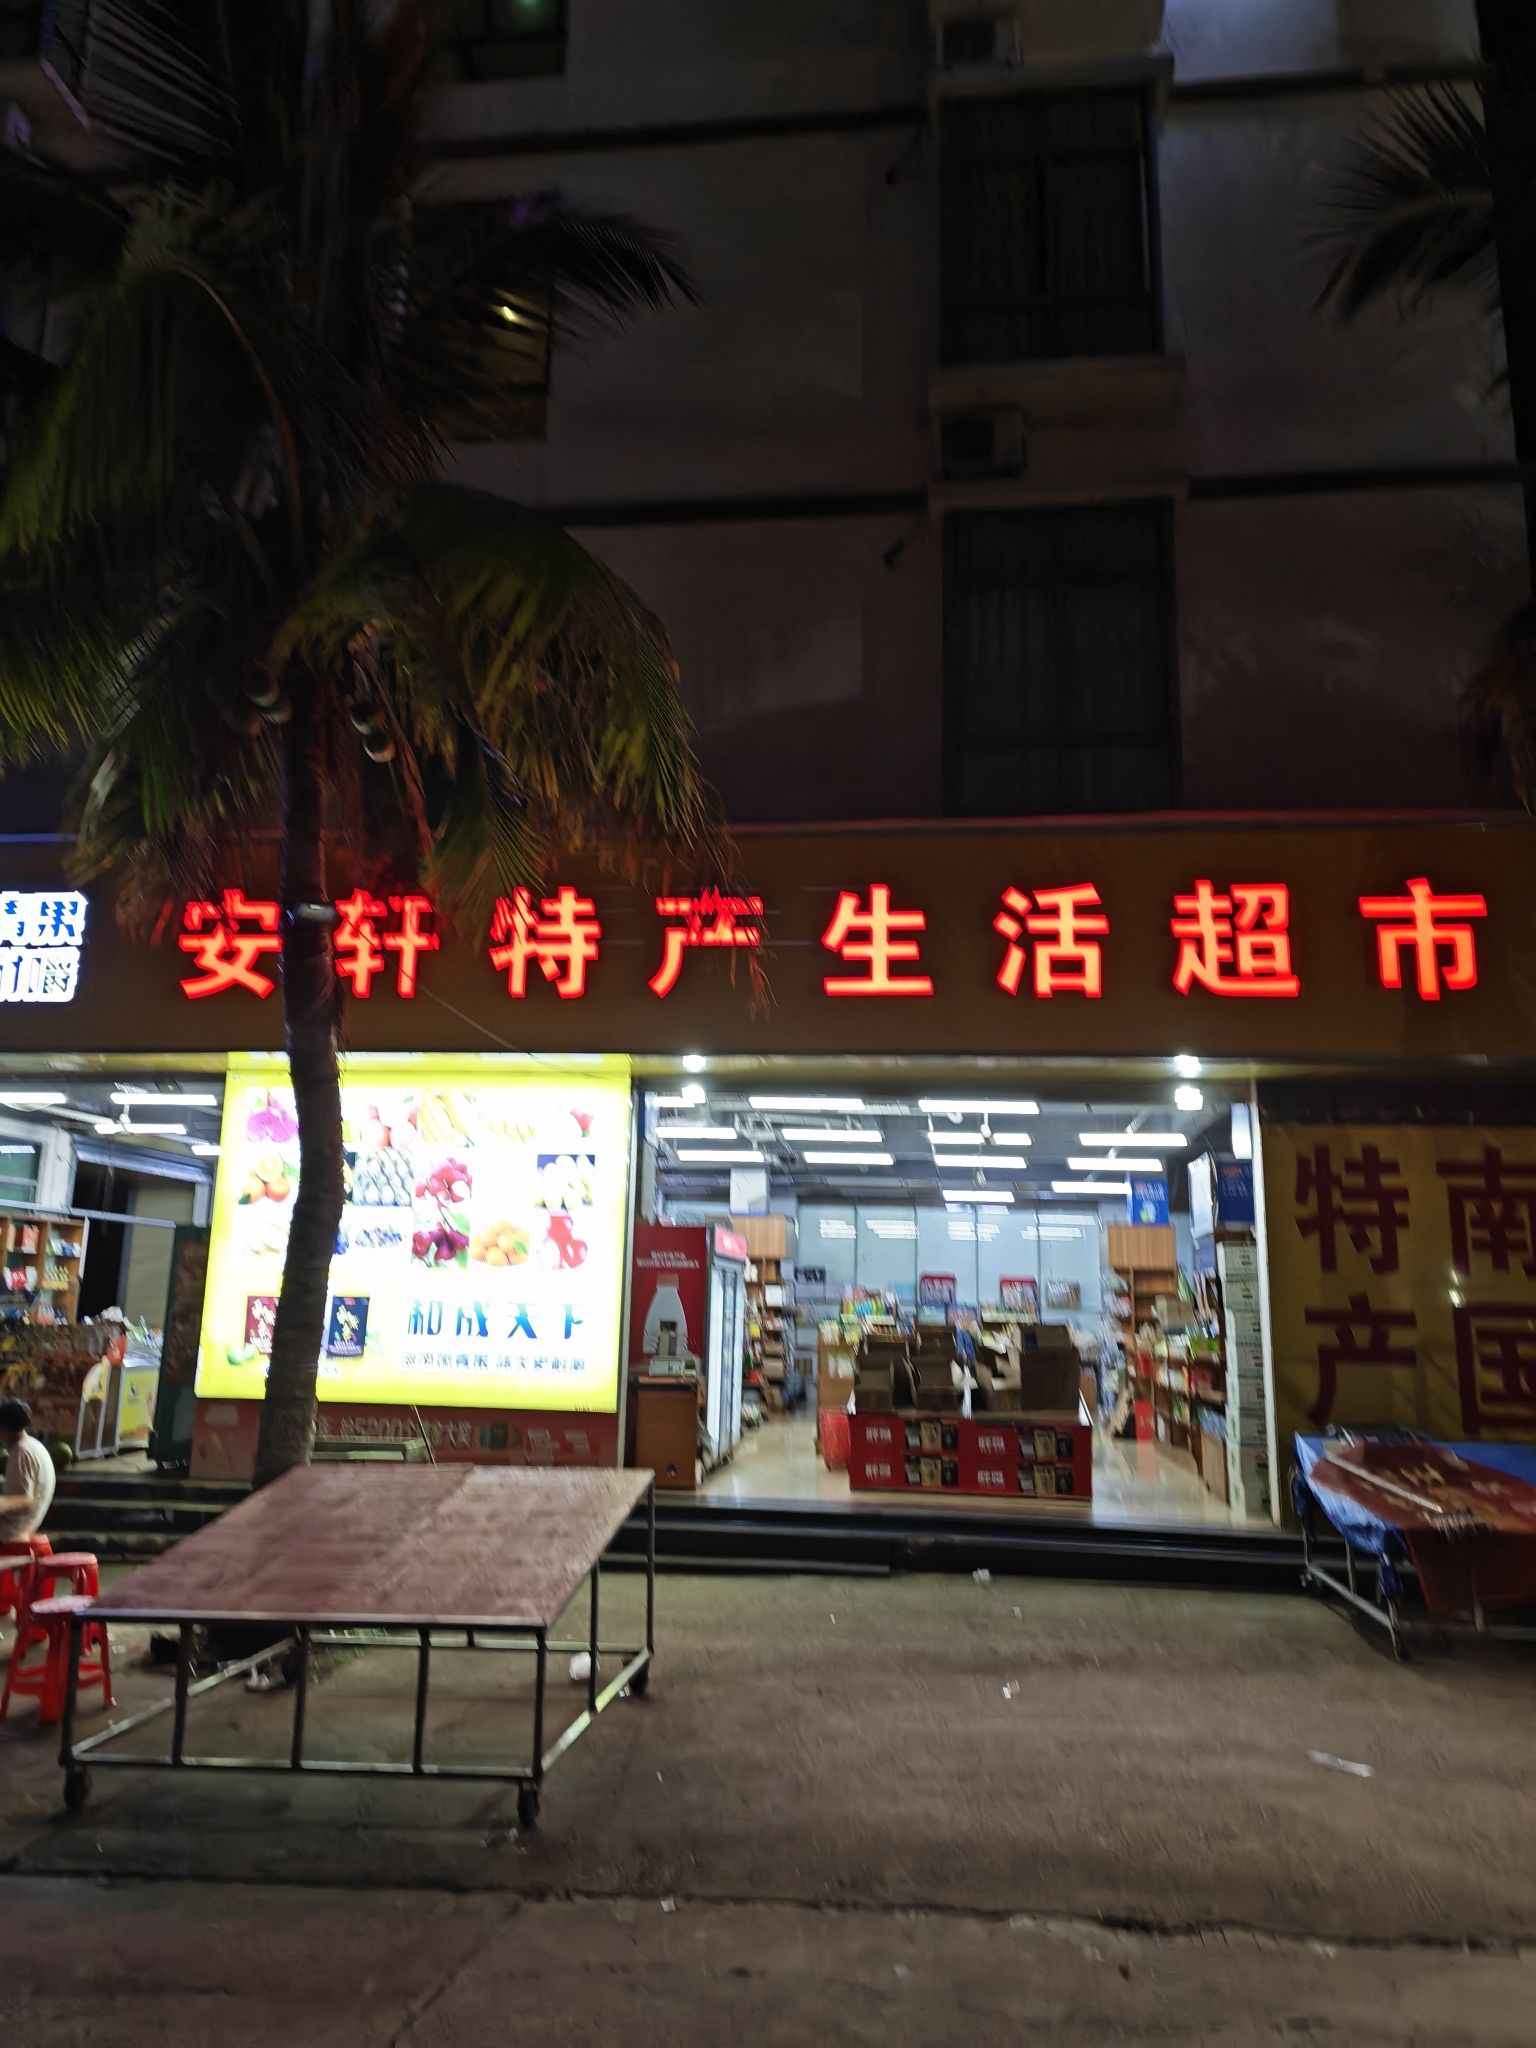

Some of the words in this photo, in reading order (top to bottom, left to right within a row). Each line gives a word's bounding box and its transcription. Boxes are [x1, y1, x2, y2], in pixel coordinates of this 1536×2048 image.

[178, 877, 1488, 1001] 安轩特产生活超市
[1295, 1143, 1418, 1425] 特产
[1436, 1145, 1536, 1436] 南国
